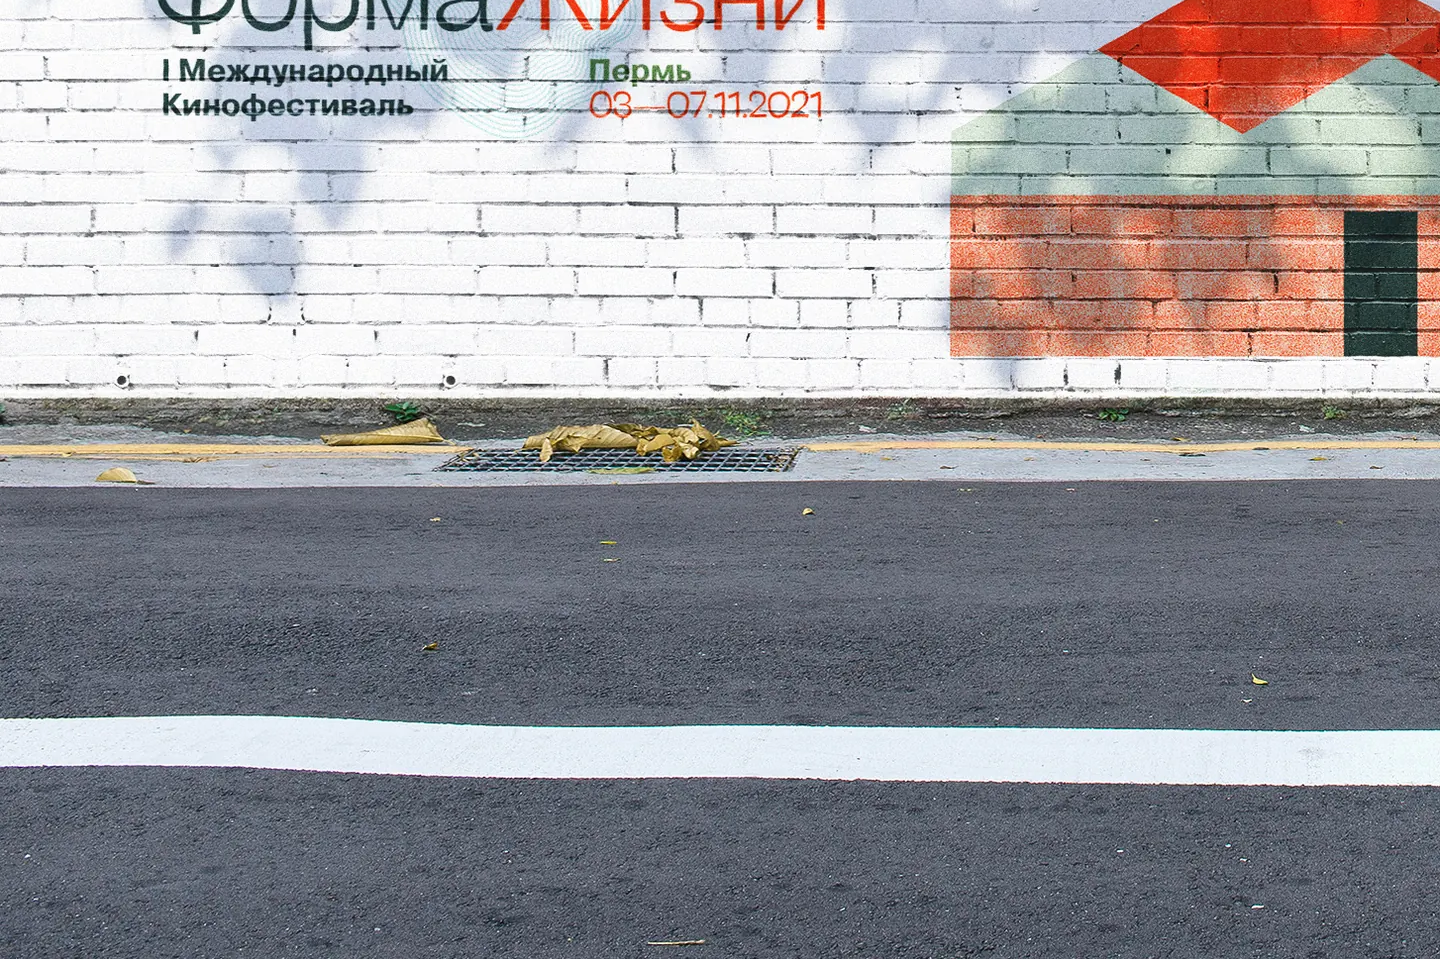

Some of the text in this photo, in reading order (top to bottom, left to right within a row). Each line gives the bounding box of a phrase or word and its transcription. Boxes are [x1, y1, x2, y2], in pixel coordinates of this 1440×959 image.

[179, 58, 449, 87] Международный
[589, 58, 692, 87] Пермь
[162, 93, 414, 121] Кинофестиваль
